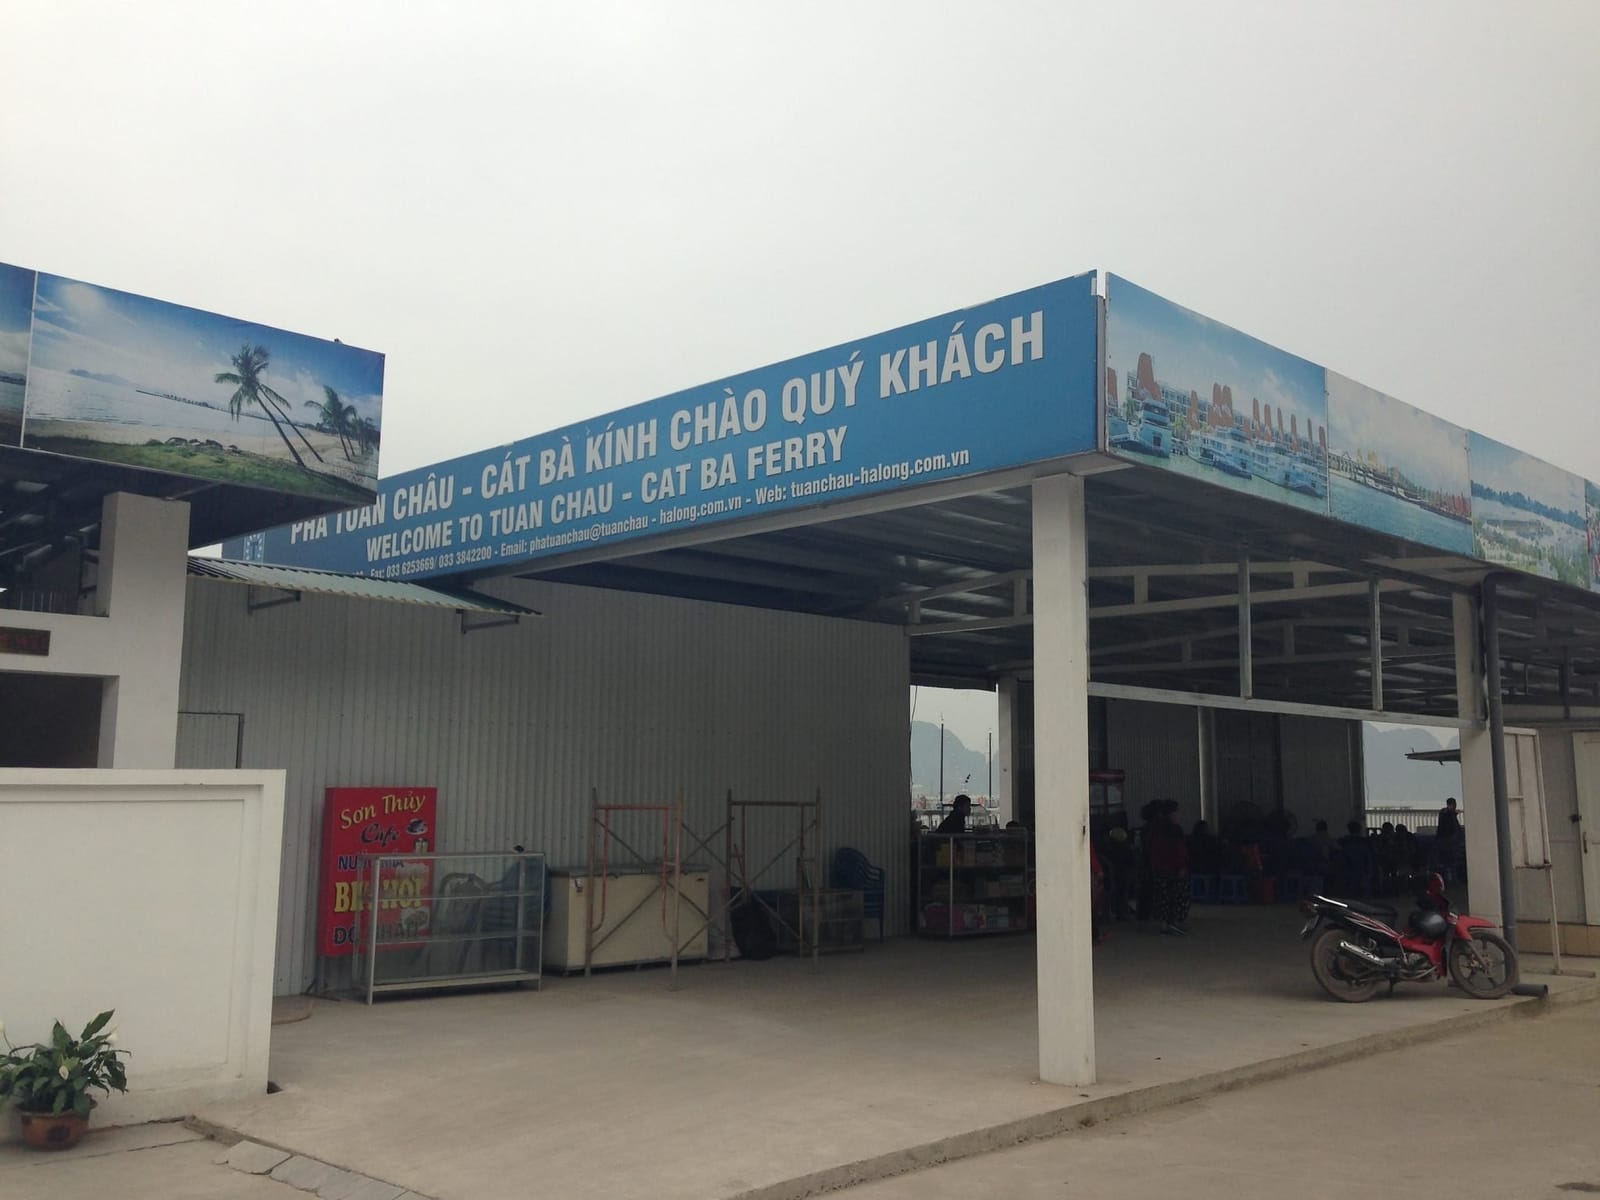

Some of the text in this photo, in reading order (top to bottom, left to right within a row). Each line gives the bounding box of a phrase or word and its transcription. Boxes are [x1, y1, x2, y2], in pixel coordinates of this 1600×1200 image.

[393, 473, 455, 521] CHÂU
[481, 452, 531, 499] CÁT
[539, 436, 575, 486] BÀ
[585, 419, 657, 473] KÍNH
[670, 387, 767, 451] CHÀO
[782, 350, 864, 424] QUÝ
[879, 310, 1044, 398] KHÁCH
[367, 520, 453, 562] WELCOME
[459, 512, 482, 543] TO
[490, 499, 543, 537] TUAN
[551, 482, 613, 524] CHAU
[641, 463, 691, 503] CAT
[700, 453, 737, 491] BA
[747, 425, 848, 481] FERRY
[438, 553, 454, 568] 033
[455, 547, 492, 566] 3842200
[501, 542, 527, 557] Email:
[529, 516, 648, 553] phatuanchau@tuanchau
[659, 497, 742, 525] halong.com.vn
[755, 487, 787, 505] Web:
[790, 449, 970, 499] tuanchau-halong.com.vn
